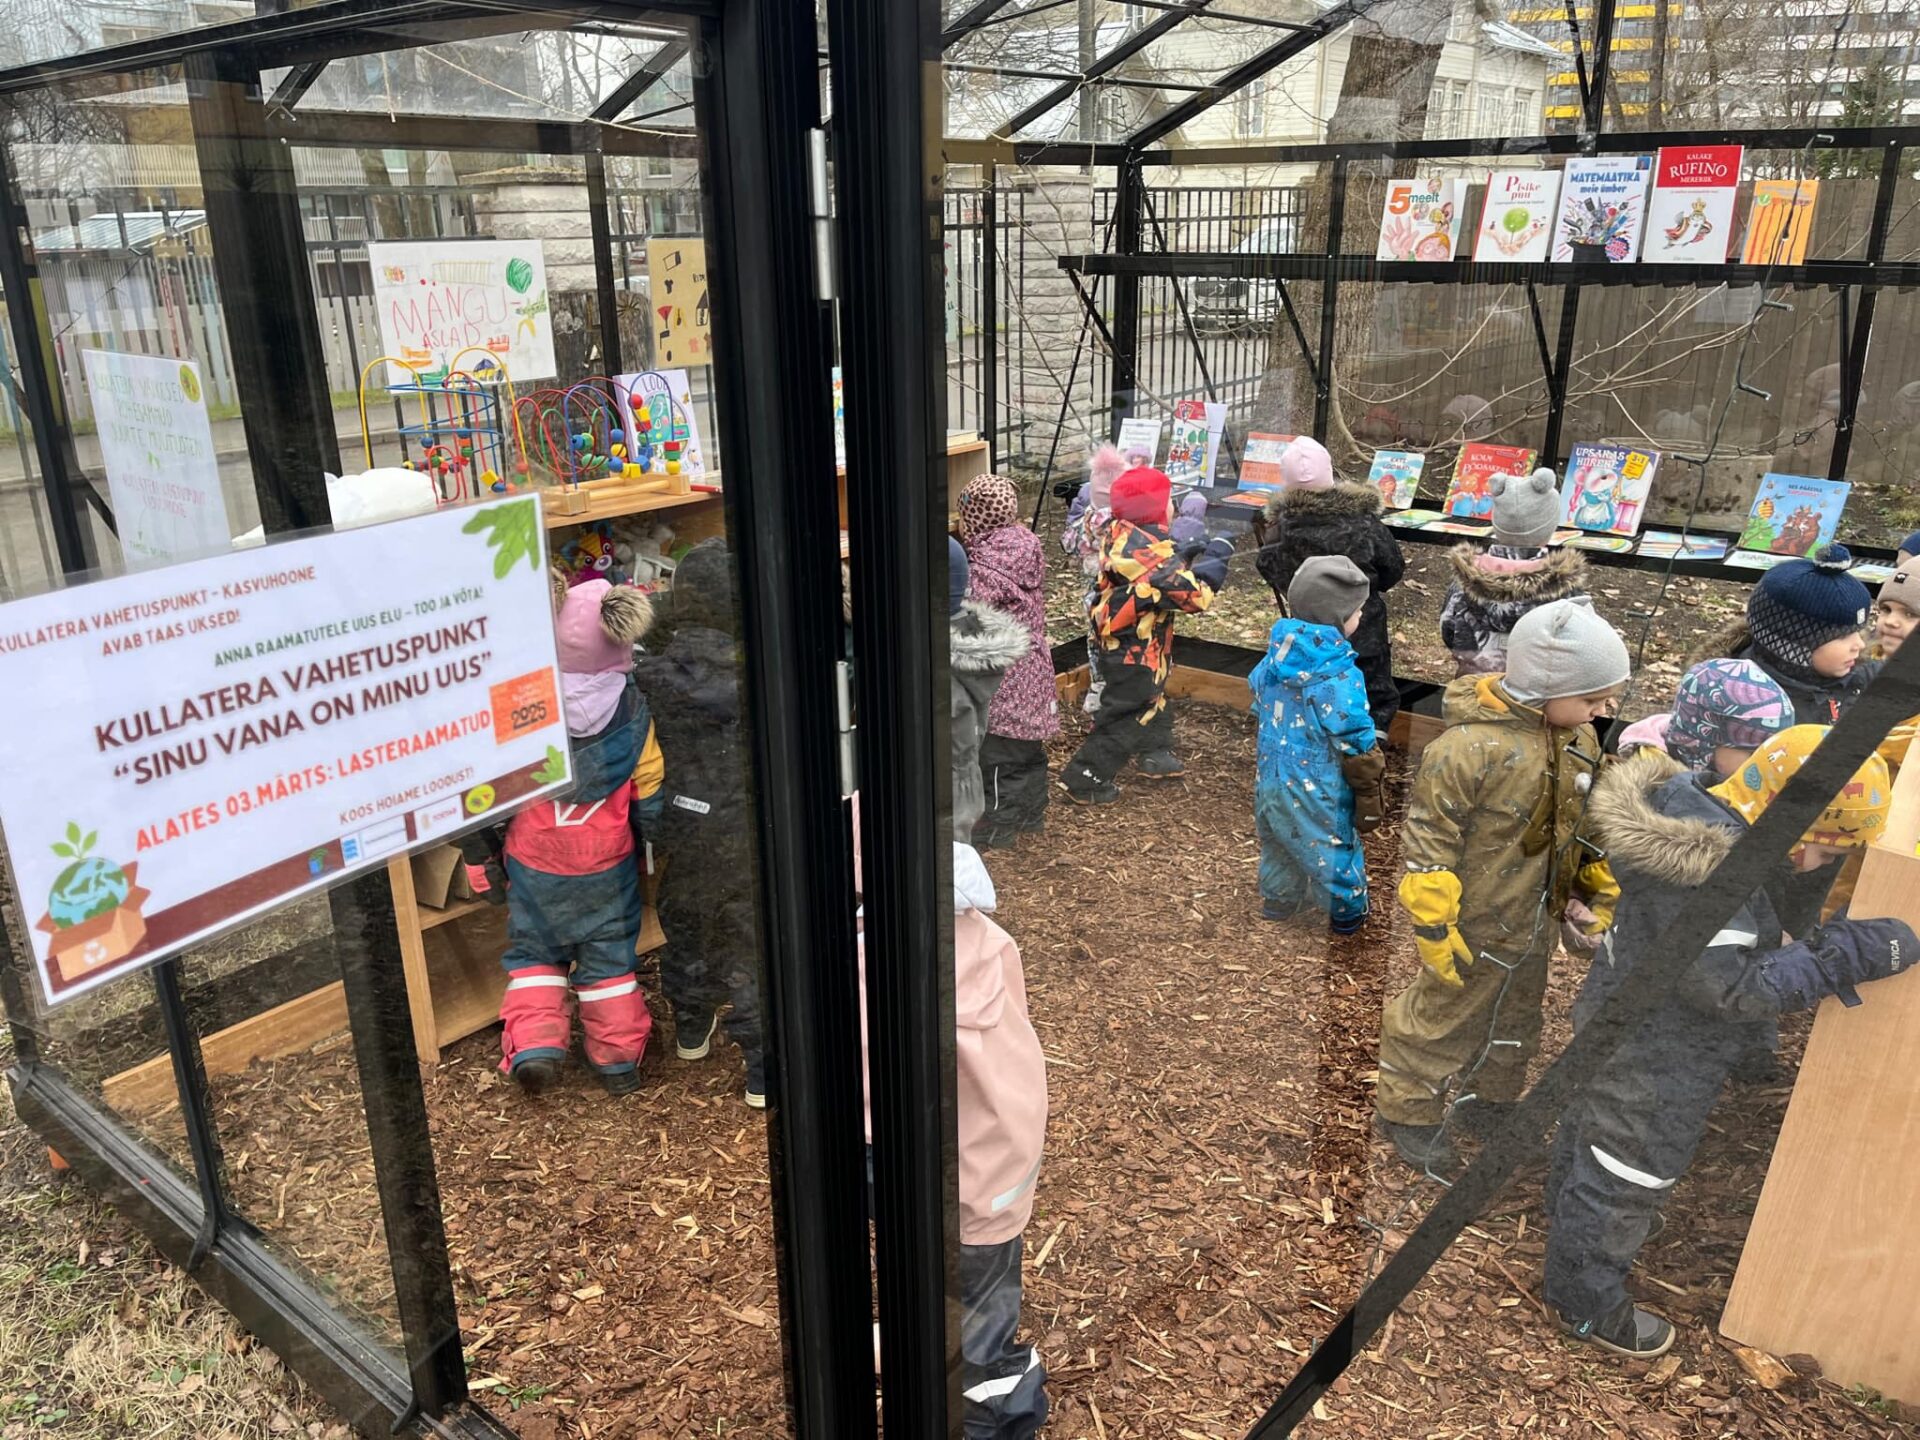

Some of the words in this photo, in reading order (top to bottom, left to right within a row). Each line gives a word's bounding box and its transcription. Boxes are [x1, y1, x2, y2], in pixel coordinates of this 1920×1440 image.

[1505, 175, 1541, 192] Pisike
[1570, 172, 1641, 183] MATEMAATIKA
[1669, 162, 1728, 178] RUFINO
[1388, 186, 1412, 215] 5
[1409, 191, 1440, 203] meelt
[1580, 184, 1600, 193] meie
[91, 590, 207, 630] VAHETUSPUNKT
[222, 566, 316, 600] KASVUHOONE
[102, 631, 142, 657] AVAB
[146, 622, 184, 645] TAAS
[187, 609, 241, 635] UKSED!
[214, 643, 253, 668] ANNA
[255, 620, 349, 657] RAAMATUTELE
[352, 614, 377, 632] UUS
[380, 608, 402, 625] ELU
[414, 598, 437, 617] TOO
[439, 594, 452, 610] JA
[453, 586, 484, 607] VÕTA!
[94, 676, 278, 752] KULLATERA
[282, 616, 489, 692] VAHETUSPUNKT
[214, 710, 304, 755] VANA
[311, 696, 355, 726] ON
[362, 672, 429, 712] MINU
[510, 700, 547, 731] 2025
[135, 803, 221, 852] ALATES
[226, 764, 333, 817] 03.MÄRTS:
[337, 710, 491, 779] LASTERAAMATUD
[339, 800, 375, 825] KOOS
[377, 786, 421, 813] HOIAME
[1889, 939, 1900, 971] NEVICA
